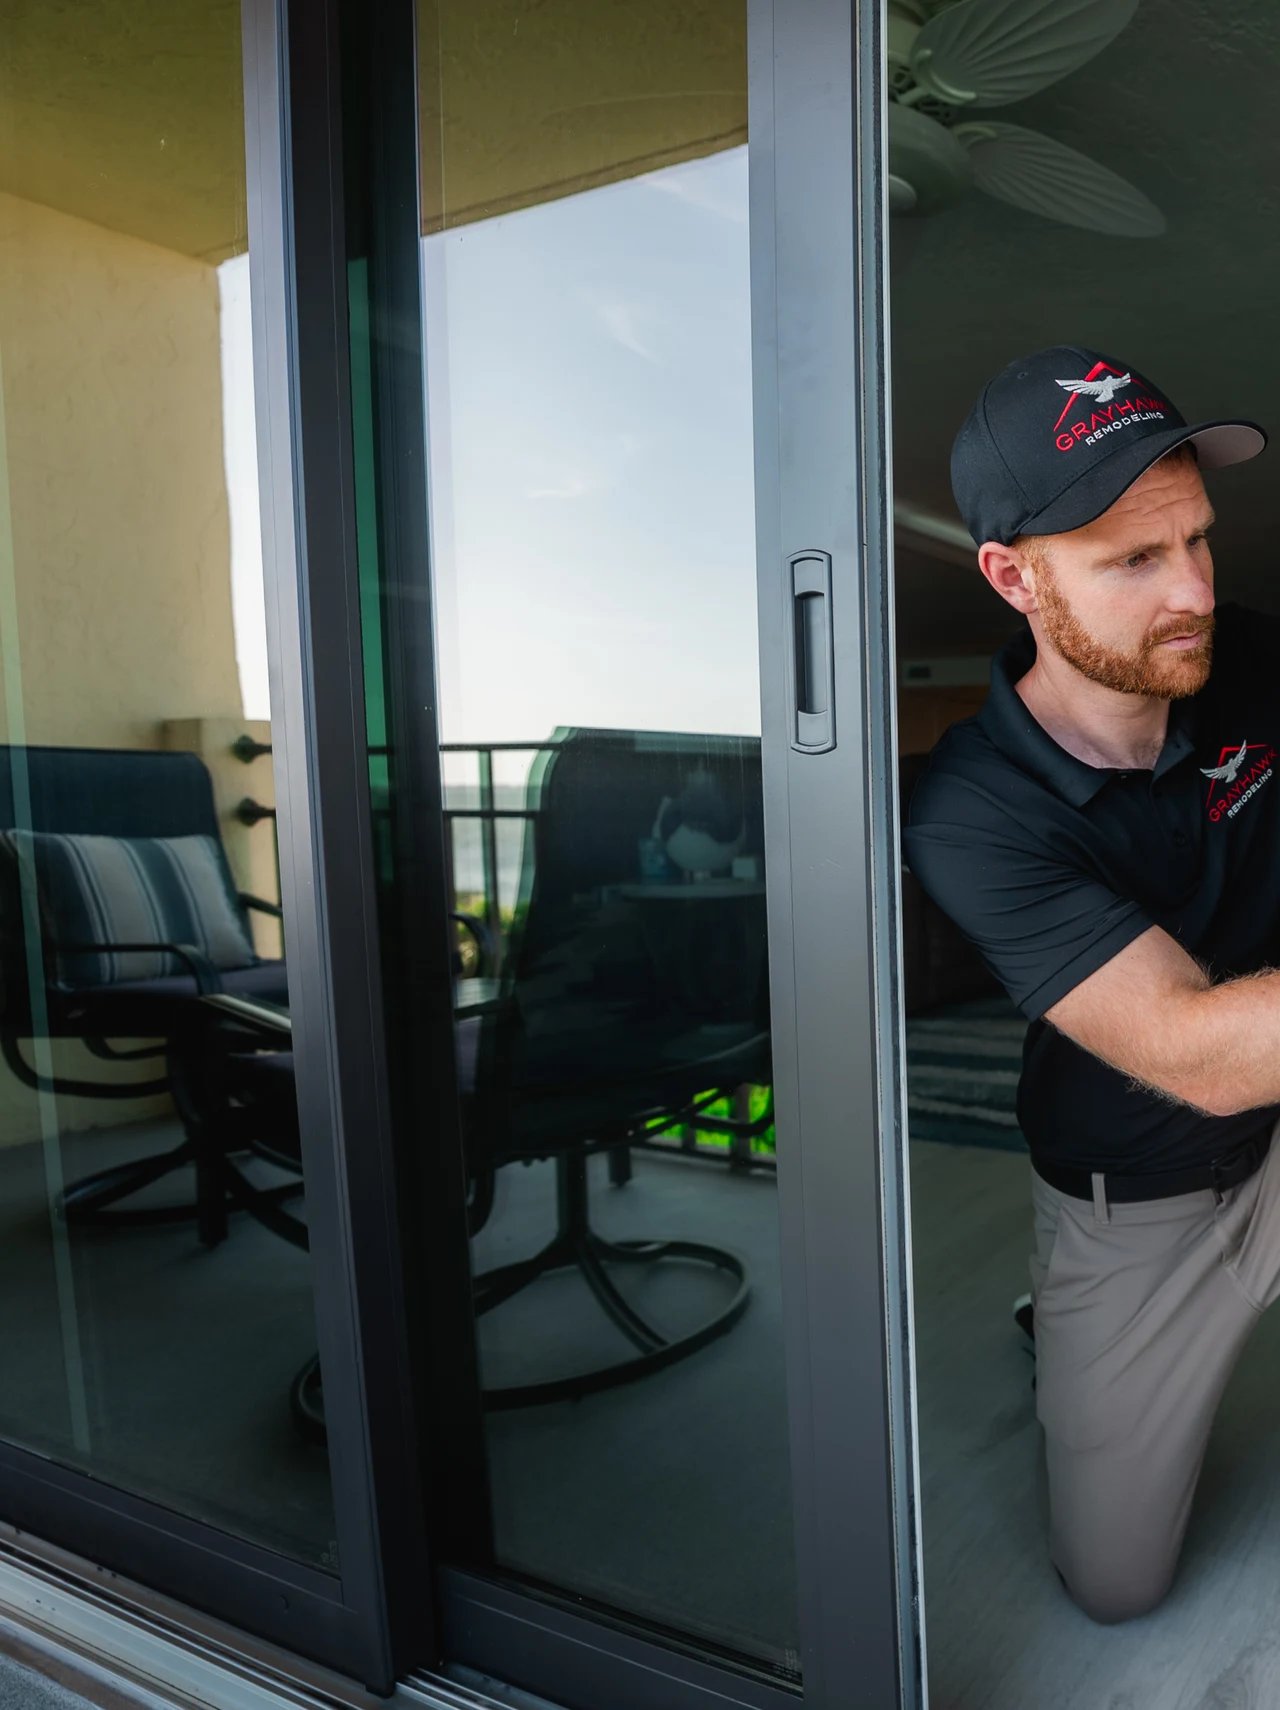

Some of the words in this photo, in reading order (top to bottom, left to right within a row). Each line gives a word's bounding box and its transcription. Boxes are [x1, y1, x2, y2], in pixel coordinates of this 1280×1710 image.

[1085, 411, 1164, 446] REMODELING
[1209, 747, 1278, 821] GRAYHAWK
[1227, 768, 1273, 818] REMODELING
